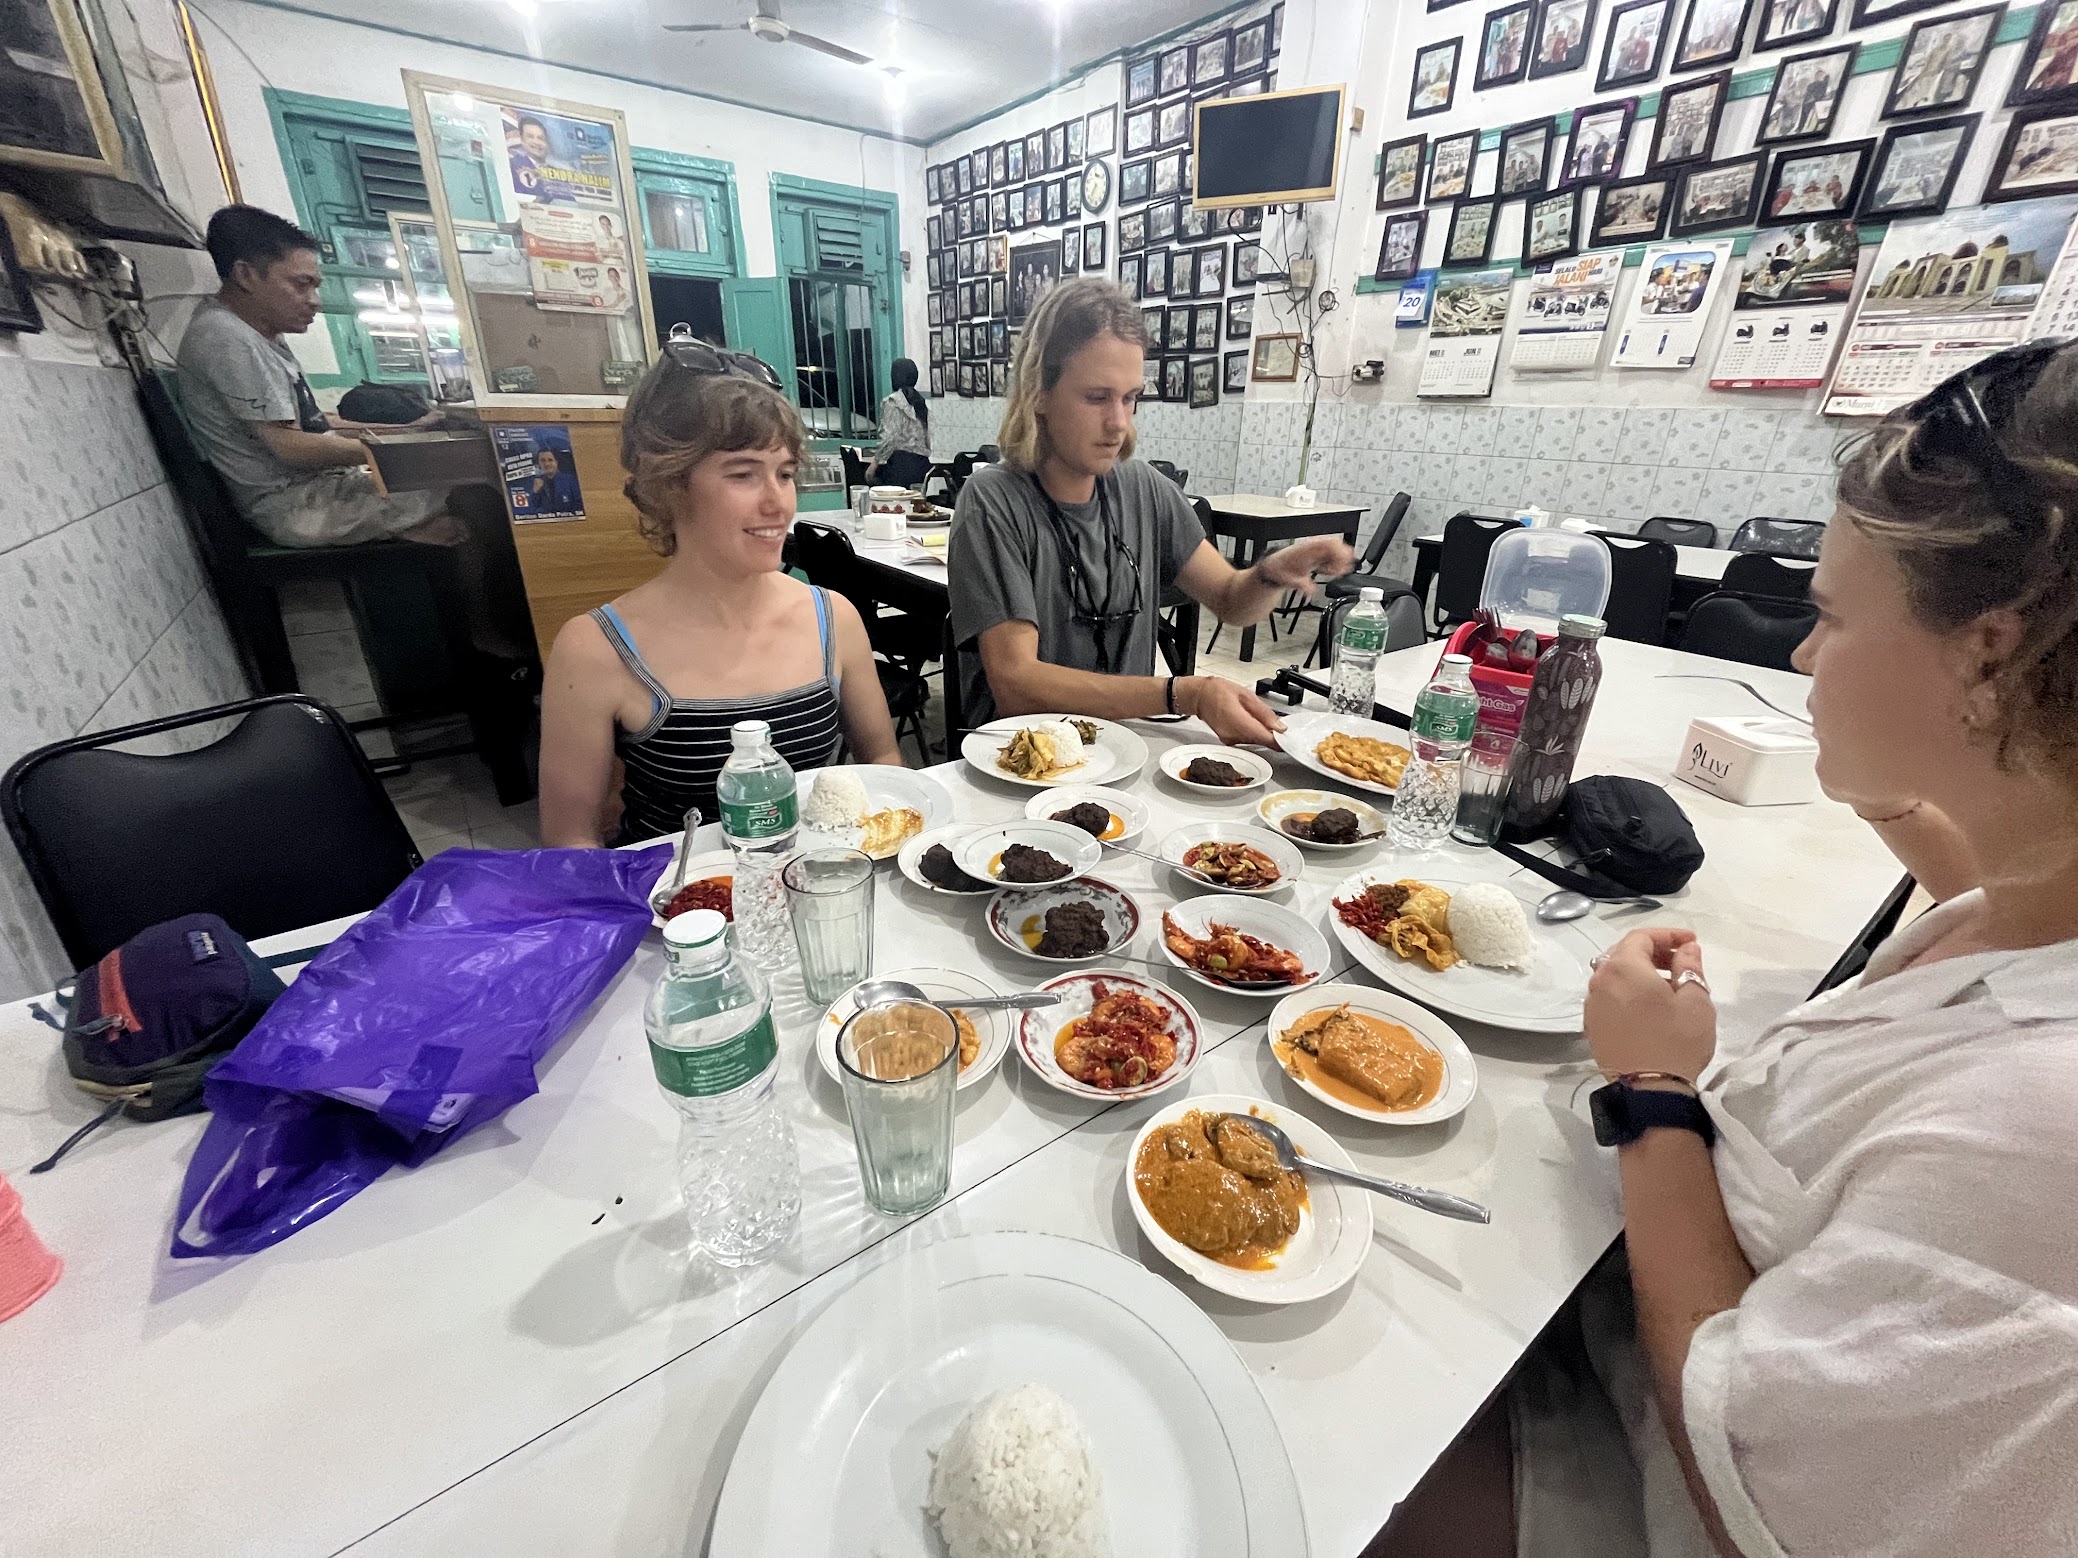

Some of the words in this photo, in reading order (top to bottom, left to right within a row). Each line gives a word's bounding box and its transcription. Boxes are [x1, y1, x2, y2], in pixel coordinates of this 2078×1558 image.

[1577, 258, 1602, 271] SIAP
[1554, 271, 1588, 285] JALANI
[1403, 296, 1421, 307] 20
[2057, 300, 2066, 309] 5
[516, 495, 526, 506] 8
[1494, 700, 1516, 712] Gas
[755, 818, 776, 826] SMS
